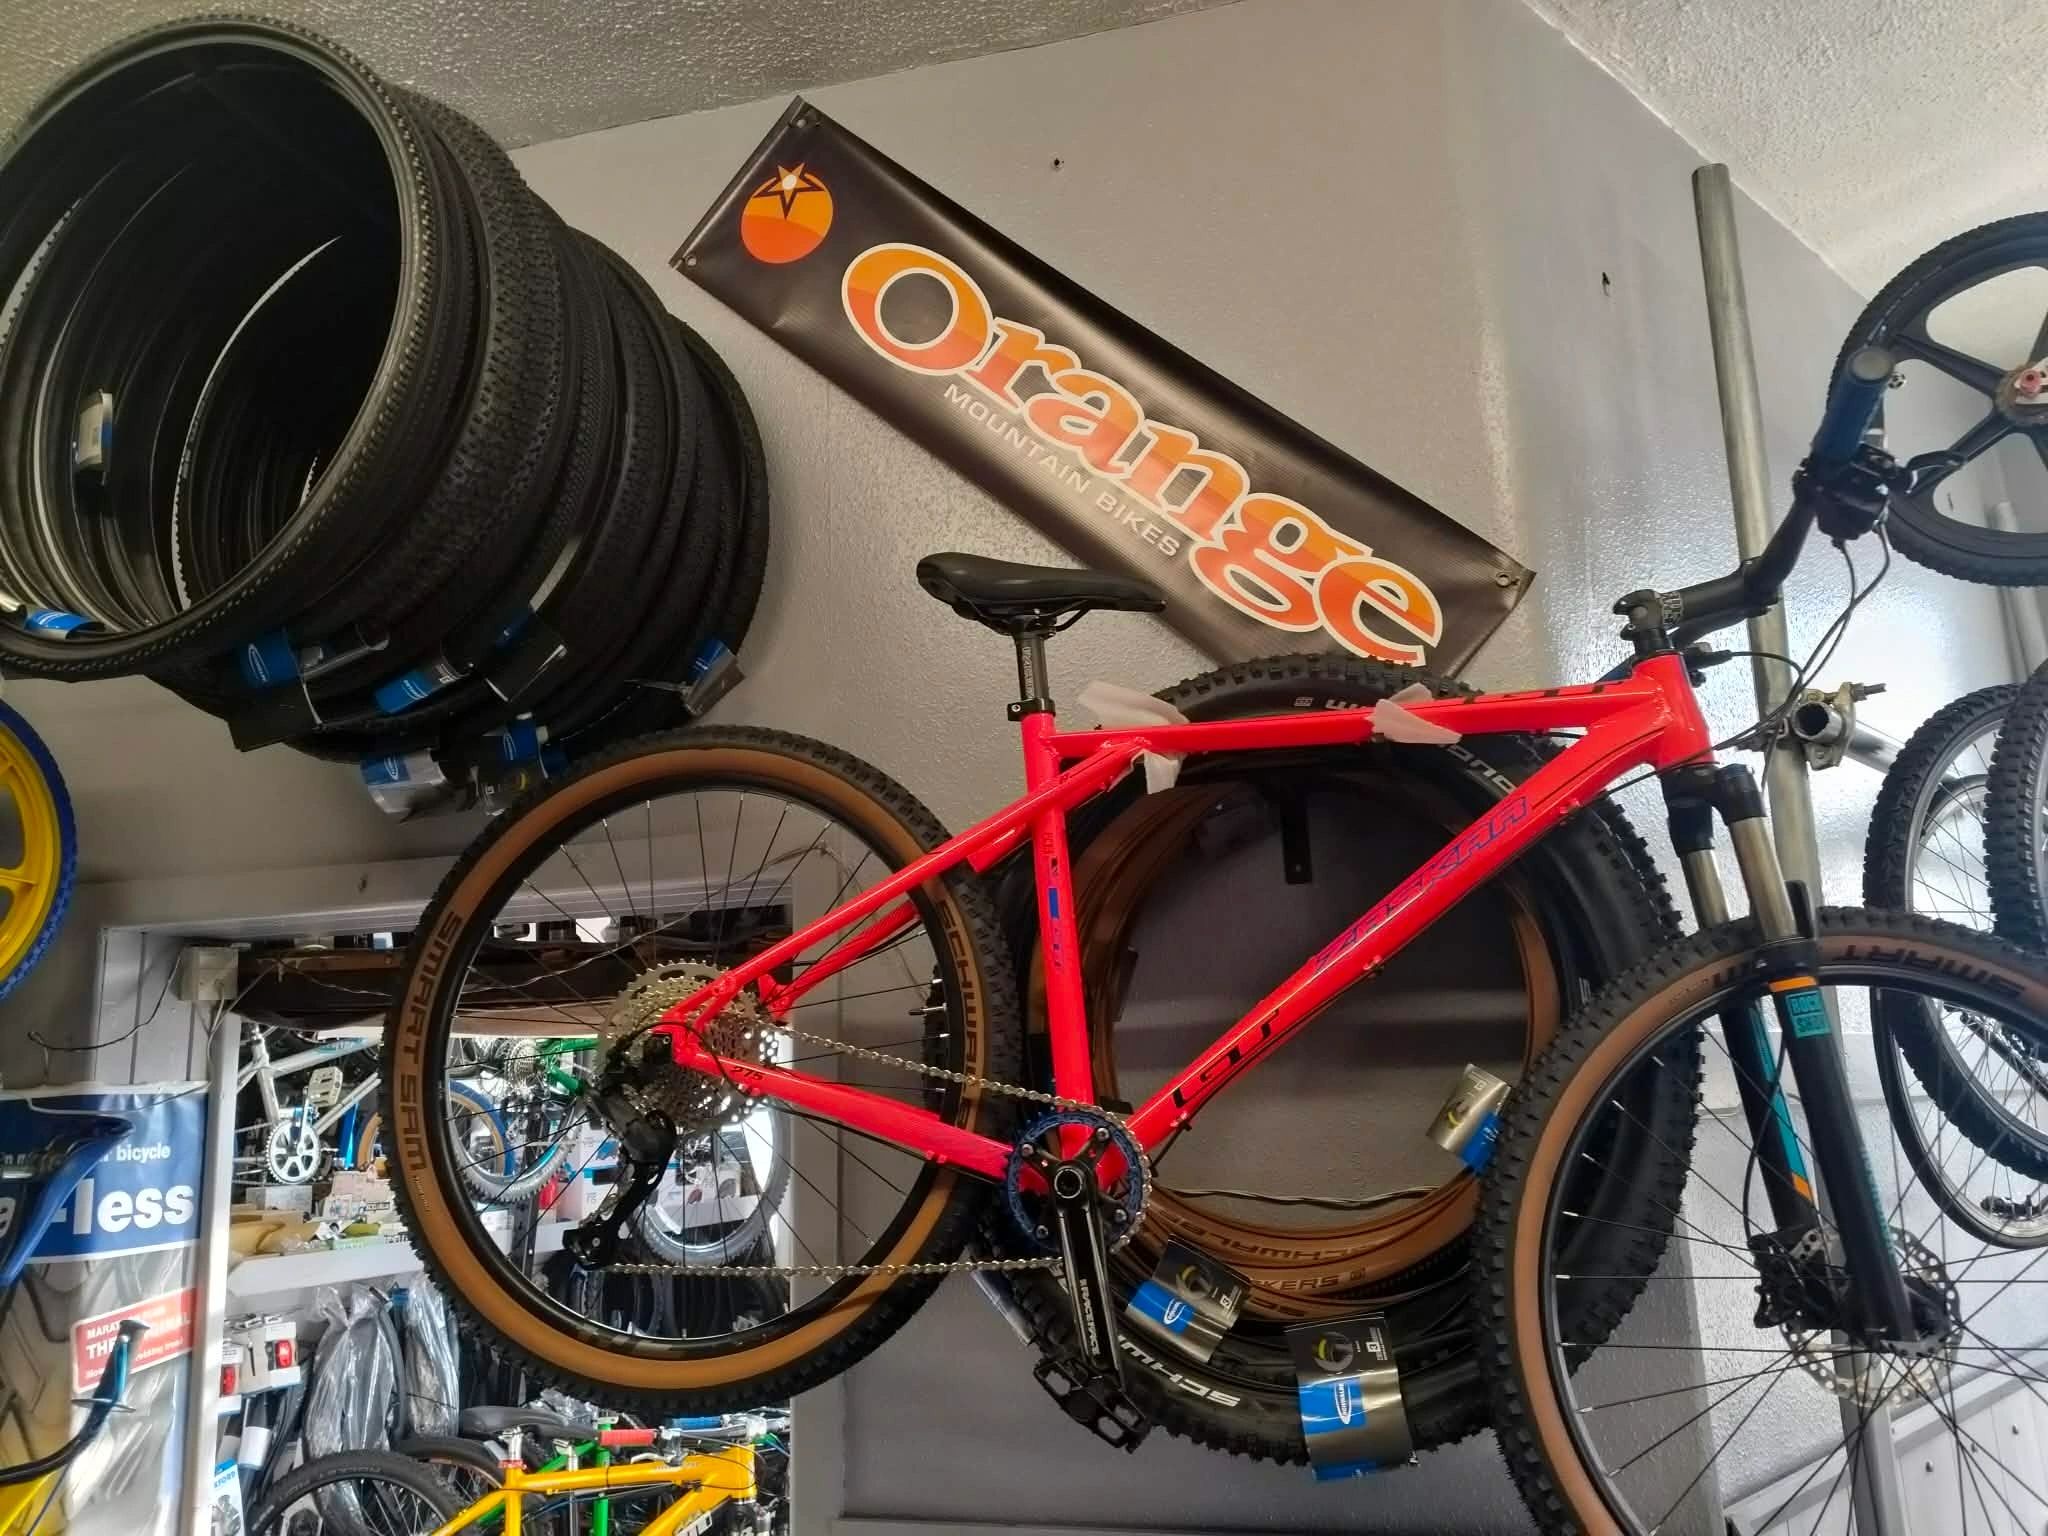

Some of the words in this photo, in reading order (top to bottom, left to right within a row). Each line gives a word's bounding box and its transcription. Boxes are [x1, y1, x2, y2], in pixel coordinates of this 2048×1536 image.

[842, 242, 1443, 667] Orange
[943, 382, 1091, 507] MOUNTAIN
[1094, 491, 1181, 558] BIKES
[401, 911, 463, 1065] SMART
[1831, 944, 2028, 997] SMART
[116, 1142, 171, 1164] bicycle
[400, 1073, 428, 1172] SAM
[1253, 1273, 1340, 1291] KERS
[1116, 1335, 1241, 1408] SCHW
